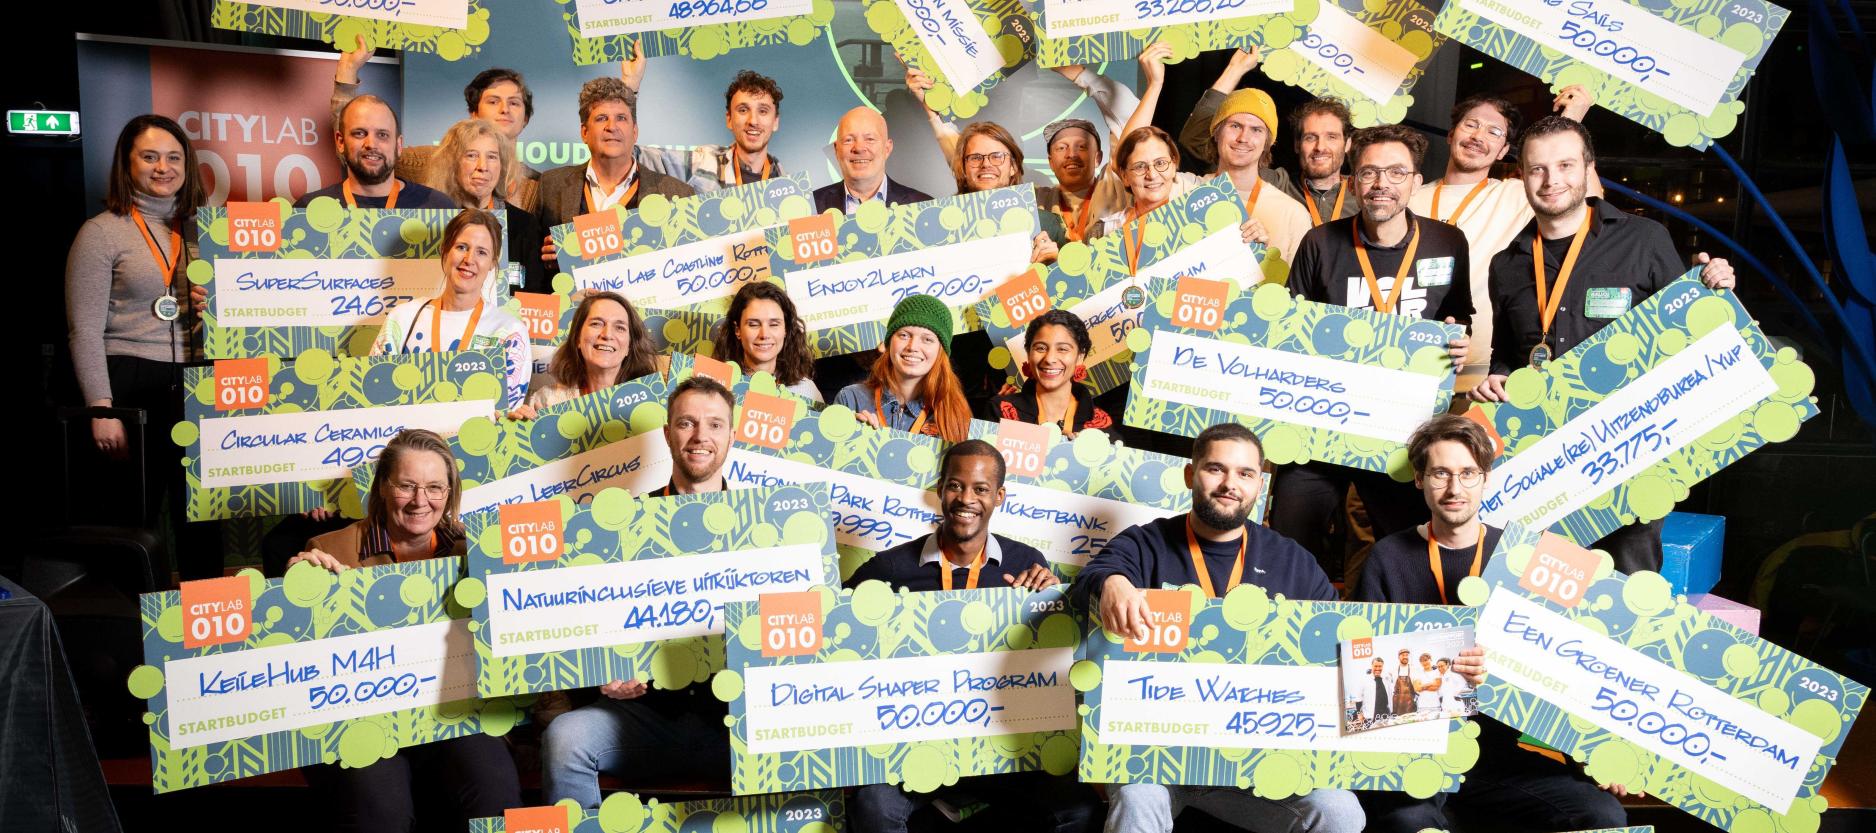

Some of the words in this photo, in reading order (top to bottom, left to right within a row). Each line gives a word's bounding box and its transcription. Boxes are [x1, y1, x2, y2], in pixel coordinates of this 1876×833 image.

[584, 14, 653, 29] STARTBUDGET
[1050, 13, 1120, 30] STARTBUDGET
[1409, 14, 1434, 33] 2023
[1476, 0, 1543, 30] ARTBUDGET
[1730, 4, 1764, 24] 2023
[1011, 19, 1030, 43] 2023
[1558, 20, 1670, 82] 50.000,-
[177, 110, 319, 147] CITYLAB
[769, 186, 796, 199] 2023
[1190, 192, 1219, 213] 2023
[991, 197, 1018, 210] 2023
[234, 218, 275, 229] CITYLAB
[582, 224, 616, 239] CITYLAB
[235, 229, 276, 247] 010
[585, 234, 619, 254] 010
[796, 228, 831, 242] CITYLAB
[798, 239, 833, 258] 010
[626, 268, 657, 285] LAB
[677, 265, 768, 297] 50.000,-
[1006, 284, 1040, 306] CITYLAB
[1181, 293, 1220, 307] CITYLAB
[1664, 287, 1701, 316] 2023
[223, 307, 308, 318] STARTBUDGET
[519, 307, 554, 318] CITYLAB
[803, 304, 870, 324] TARTBUDGET
[1012, 294, 1046, 321] 010
[1178, 305, 1218, 326] 010
[1408, 331, 1442, 346] 2023
[454, 360, 487, 373] 2023
[220, 374, 263, 387] CITYLAB
[1150, 379, 1233, 402] STARTBUDGET
[221, 386, 263, 405] 010
[616, 390, 648, 408] 2023
[1258, 386, 1372, 425] 50.000,-
[747, 409, 786, 425] CITYLAB
[743, 420, 784, 444] 010
[1002, 438, 1041, 452] CITYLAB
[1002, 448, 1039, 472] 010
[208, 462, 296, 479] STARTBUDGET
[773, 498, 809, 512] 2023
[1517, 491, 1571, 529] TBUDGET
[507, 520, 556, 536] CITYLAB
[509, 533, 557, 557] 010
[1539, 552, 1585, 581] CITYLAB
[1529, 565, 1579, 600] 010
[190, 599, 244, 615] CITYLAB
[1029, 599, 1065, 613] 2023
[191, 614, 246, 640] 010
[767, 612, 815, 626] CITYLAB
[499, 624, 600, 646] STARTBUDGET
[767, 626, 816, 650] 010
[332, 644, 396, 675] M4H
[1353, 648, 1371, 657] 010
[309, 672, 437, 710] 50.000,-
[1799, 676, 1839, 701] 2023
[178, 706, 288, 736] STARTBUDGET
[876, 698, 1005, 731] 50.000,-
[754, 722, 853, 742] STARTBUDGET
[1107, 721, 1210, 736] STARTBUDGET
[1591, 686, 1728, 766] 50.000,-
[785, 807, 823, 822] 2023
